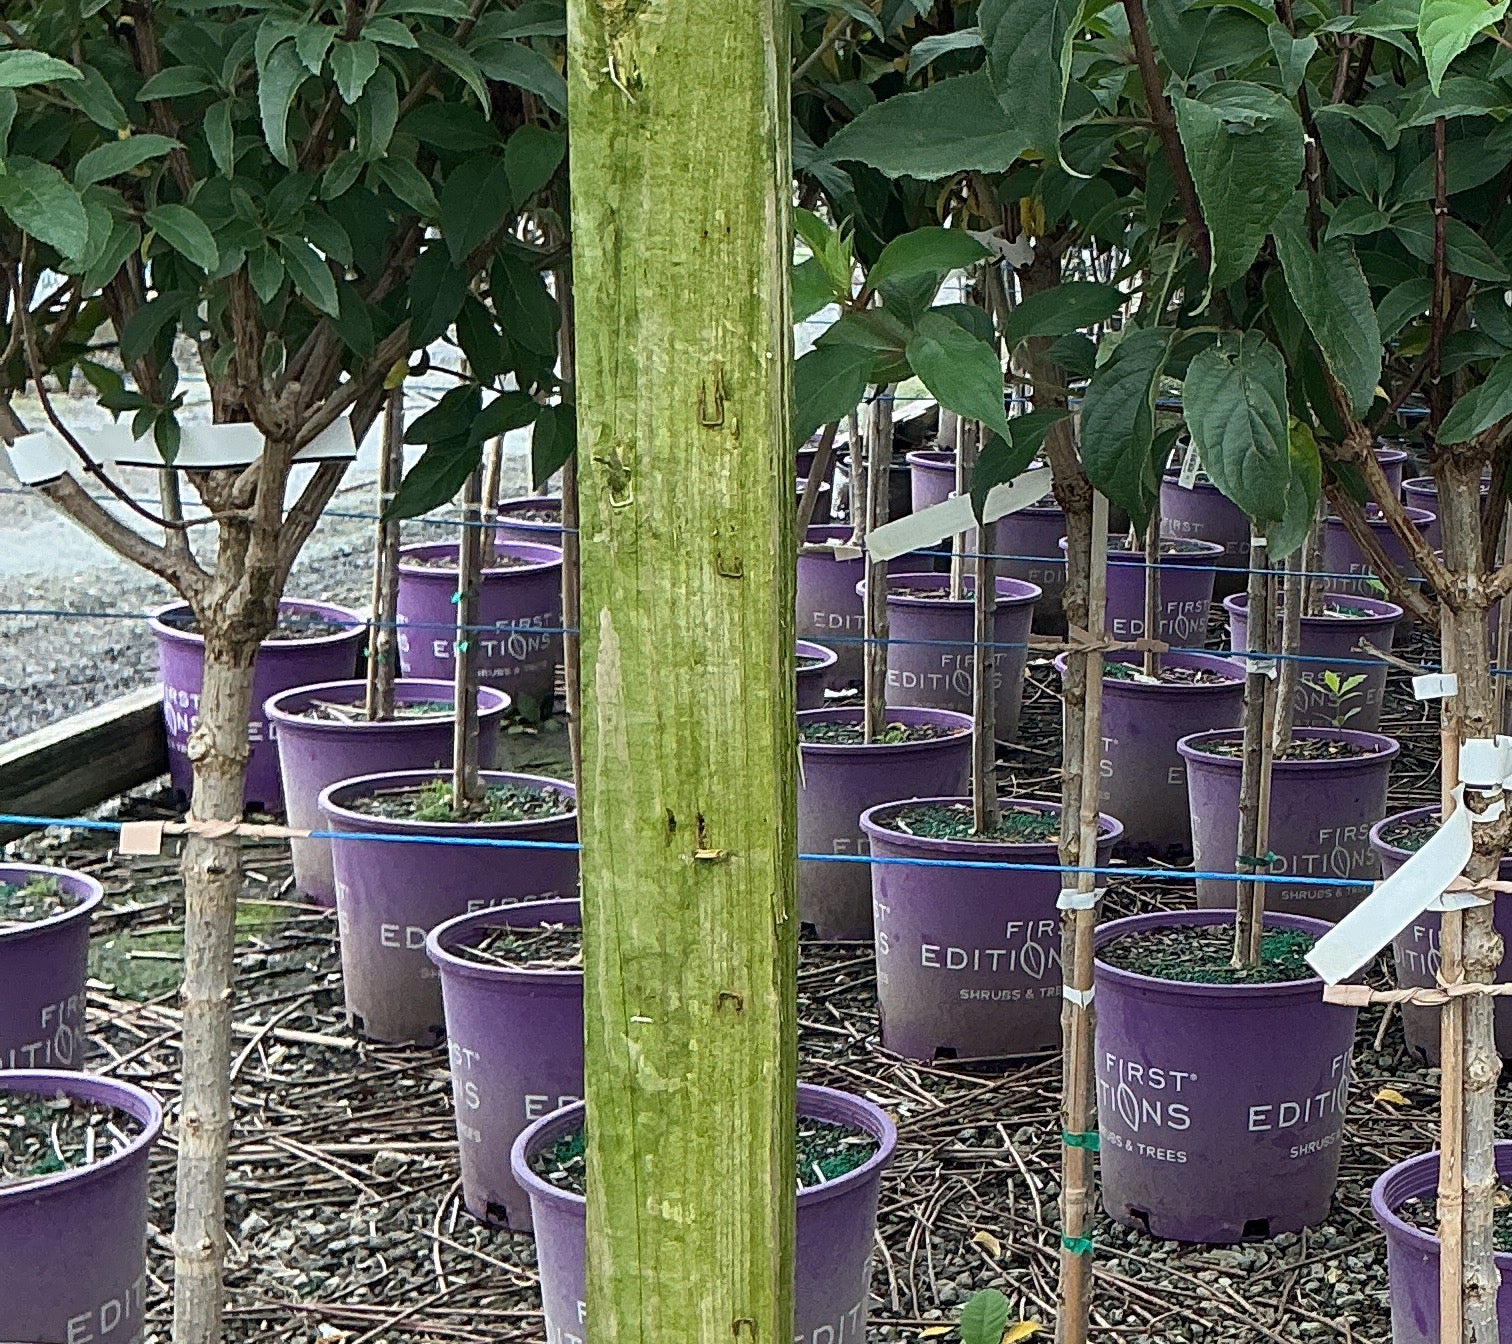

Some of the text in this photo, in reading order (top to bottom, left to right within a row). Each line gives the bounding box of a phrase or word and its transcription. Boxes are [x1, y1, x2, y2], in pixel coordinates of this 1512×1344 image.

[813, 612, 865, 629] EDIT
[1114, 615, 1206, 640] EDTIONS
[887, 669, 1003, 696] EDITIOS
[1270, 847, 1375, 878] DITIONS
[1006, 920, 1060, 942] FIR
[921, 942, 1061, 980] EDITION
[1248, 1075, 1347, 1132] EDITIO
[1137, 1142, 1187, 1163] TREES
